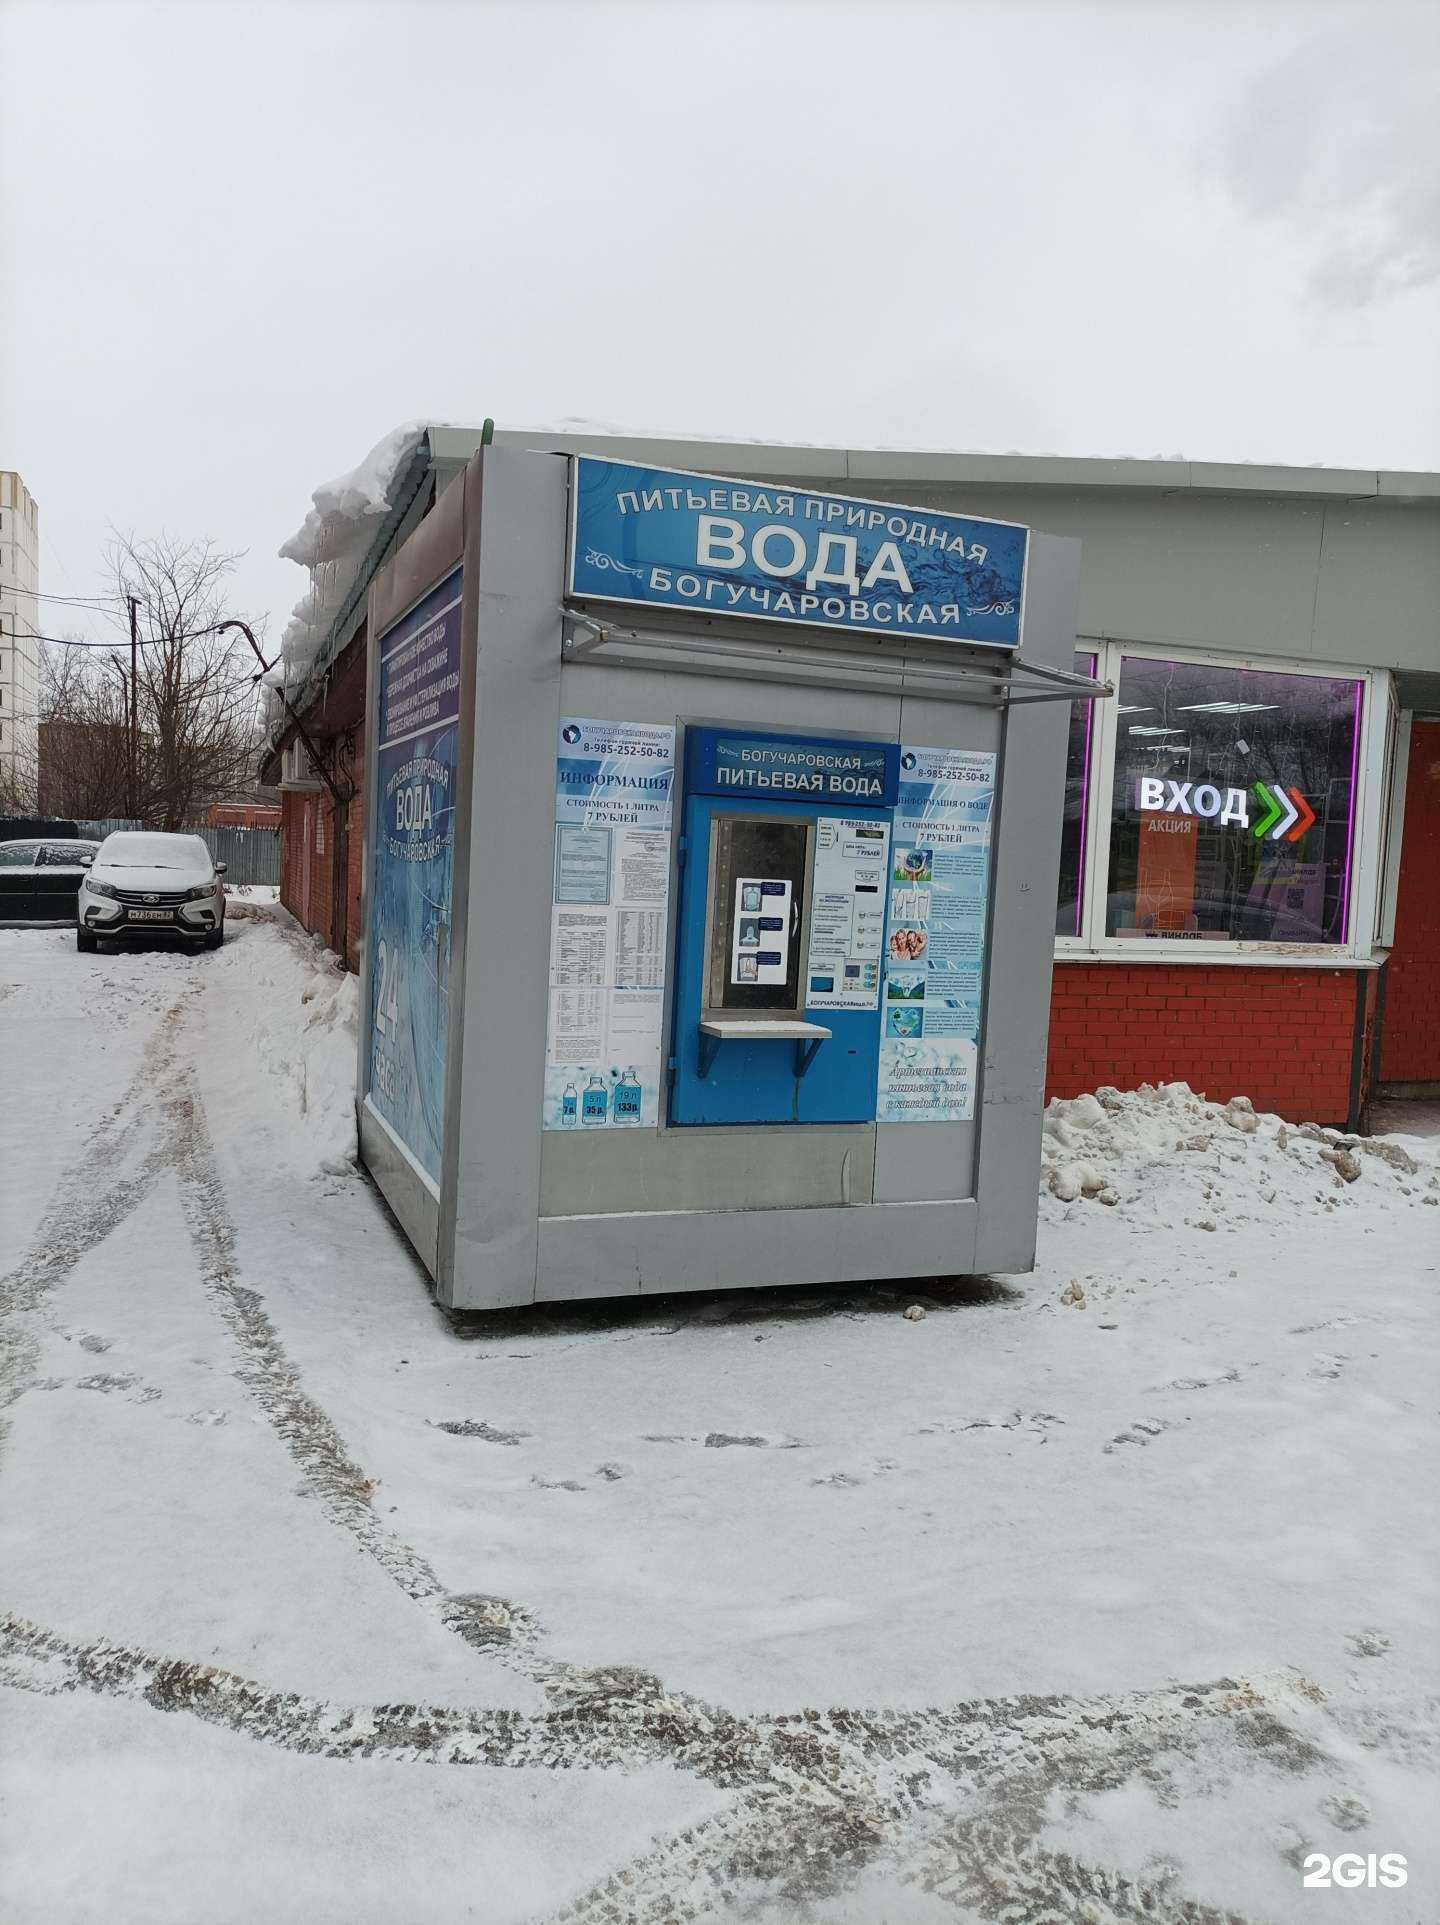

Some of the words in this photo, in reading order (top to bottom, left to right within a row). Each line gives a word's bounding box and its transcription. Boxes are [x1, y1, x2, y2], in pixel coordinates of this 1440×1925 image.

[616, 488, 796, 517] ПИТЬЕВАЯ
[804, 498, 989, 567] ПРИРОДНАЯ
[695, 514, 914, 597] ВОДА
[649, 567, 961, 626] БОГУЧАРОВСКАЯ
[583, 742, 670, 758] 8-985-252-50-82
[741, 748, 862, 770] БОГУЧАРОВСКАЯ
[412, 757, 449, 791] ПРИРОДНАЯ
[560, 771, 669, 791] ИНФОРМАЦИЯ
[717, 766, 824, 792] ПИТЬЕВАЯ
[829, 775, 883, 798] ВОДА
[917, 768, 990, 783] 8-985-252-50-82
[396, 784, 432, 841] ВОДА
[566, 798, 624, 809] СТОИМОСТЬ
[632, 803, 660, 812] ЛИТРА
[967, 801, 989, 810] ВОДЕ
[1140, 776, 1249, 829] ВХОД
[587, 811, 593, 820] 7
[596, 811, 640, 823] РУБЛЕЙ
[902, 821, 950, 831] СТОИМОСТЬ
[956, 824, 980, 833] ЛИТРА
[1147, 818, 1192, 834] АКЦИЯ
[919, 833, 925, 841] 7
[926, 833, 962, 843] РУБЛЕЙ
[389, 835, 441, 866] БОГУЧАРОВСКАЯ
[376, 938, 399, 1045] 24
